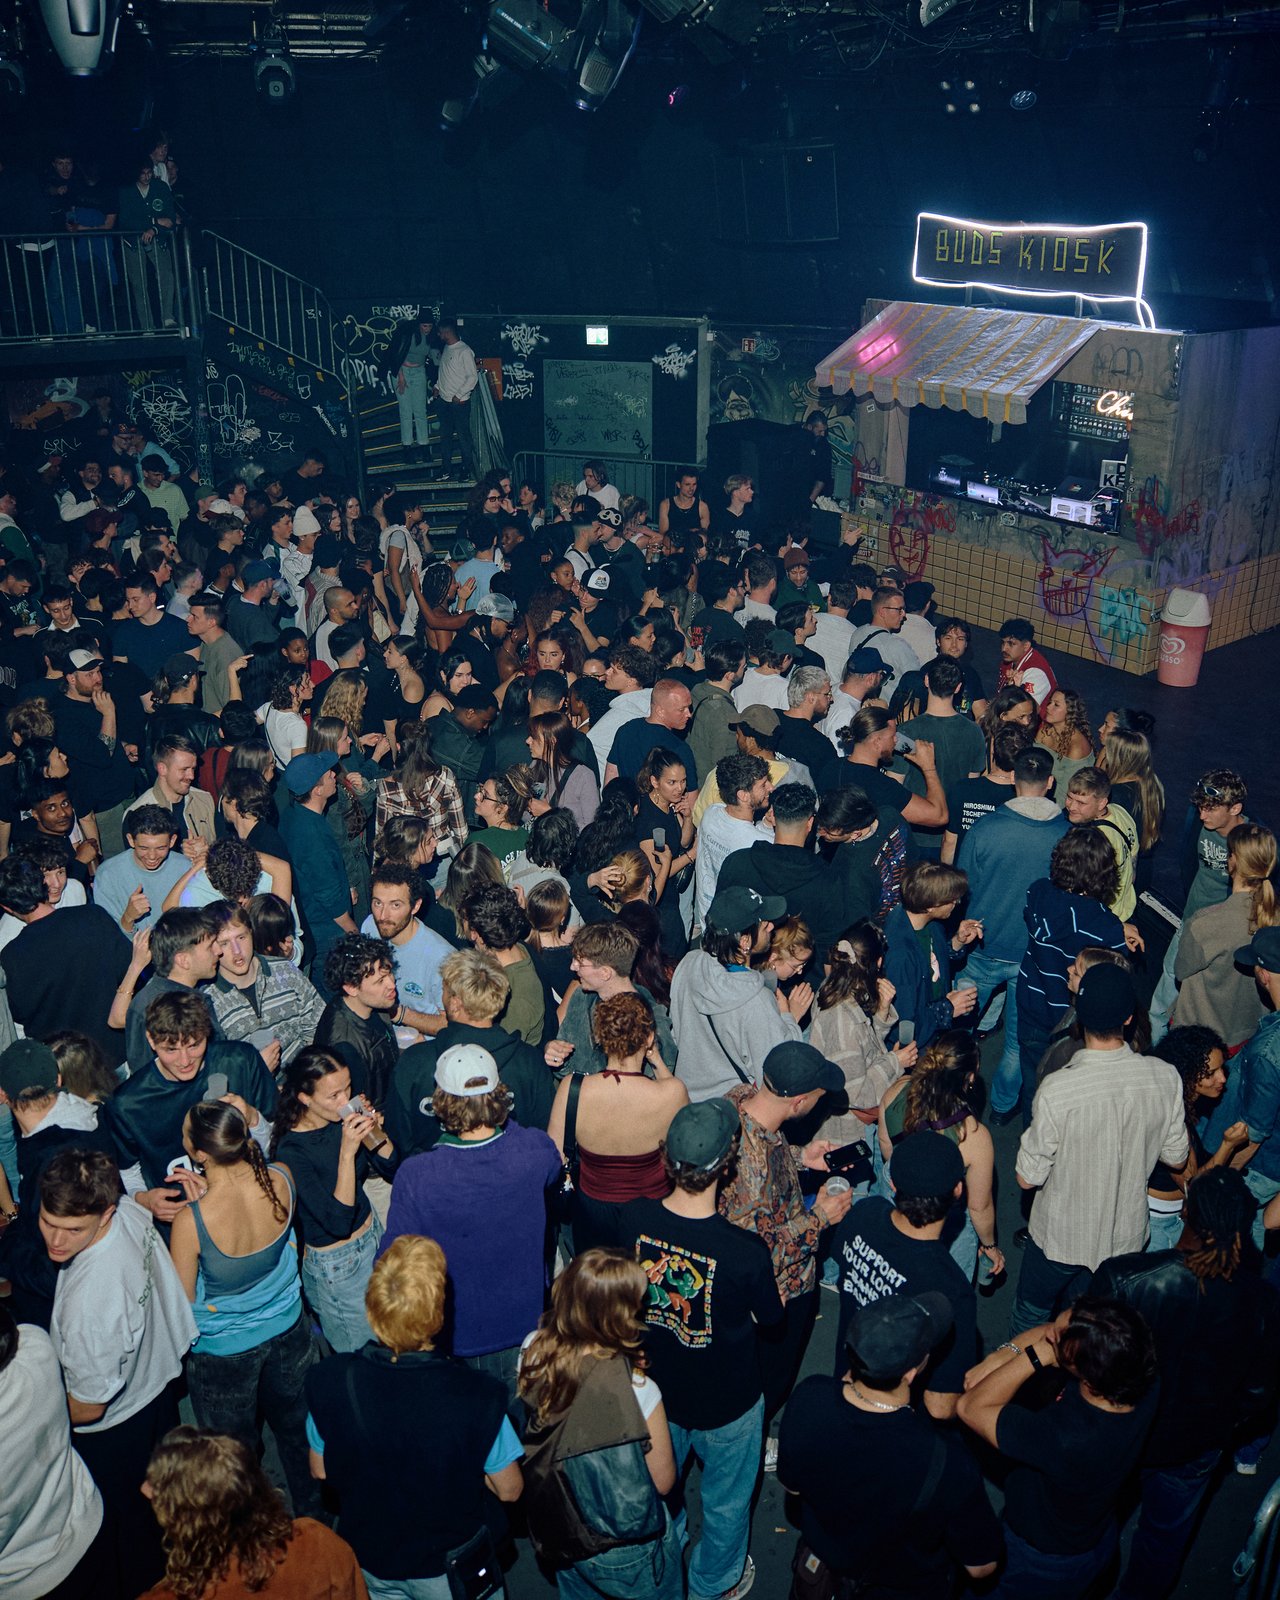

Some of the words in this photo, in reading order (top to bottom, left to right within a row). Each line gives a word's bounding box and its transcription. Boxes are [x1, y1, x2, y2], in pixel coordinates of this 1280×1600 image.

[936, 228, 1003, 265] BUDS
[1018, 235, 1115, 276] KIOSK
[963, 802, 996, 811] HIROSHIMA
[842, 1240, 870, 1278] YOUR
[852, 1234, 907, 1287] SUPPORT
